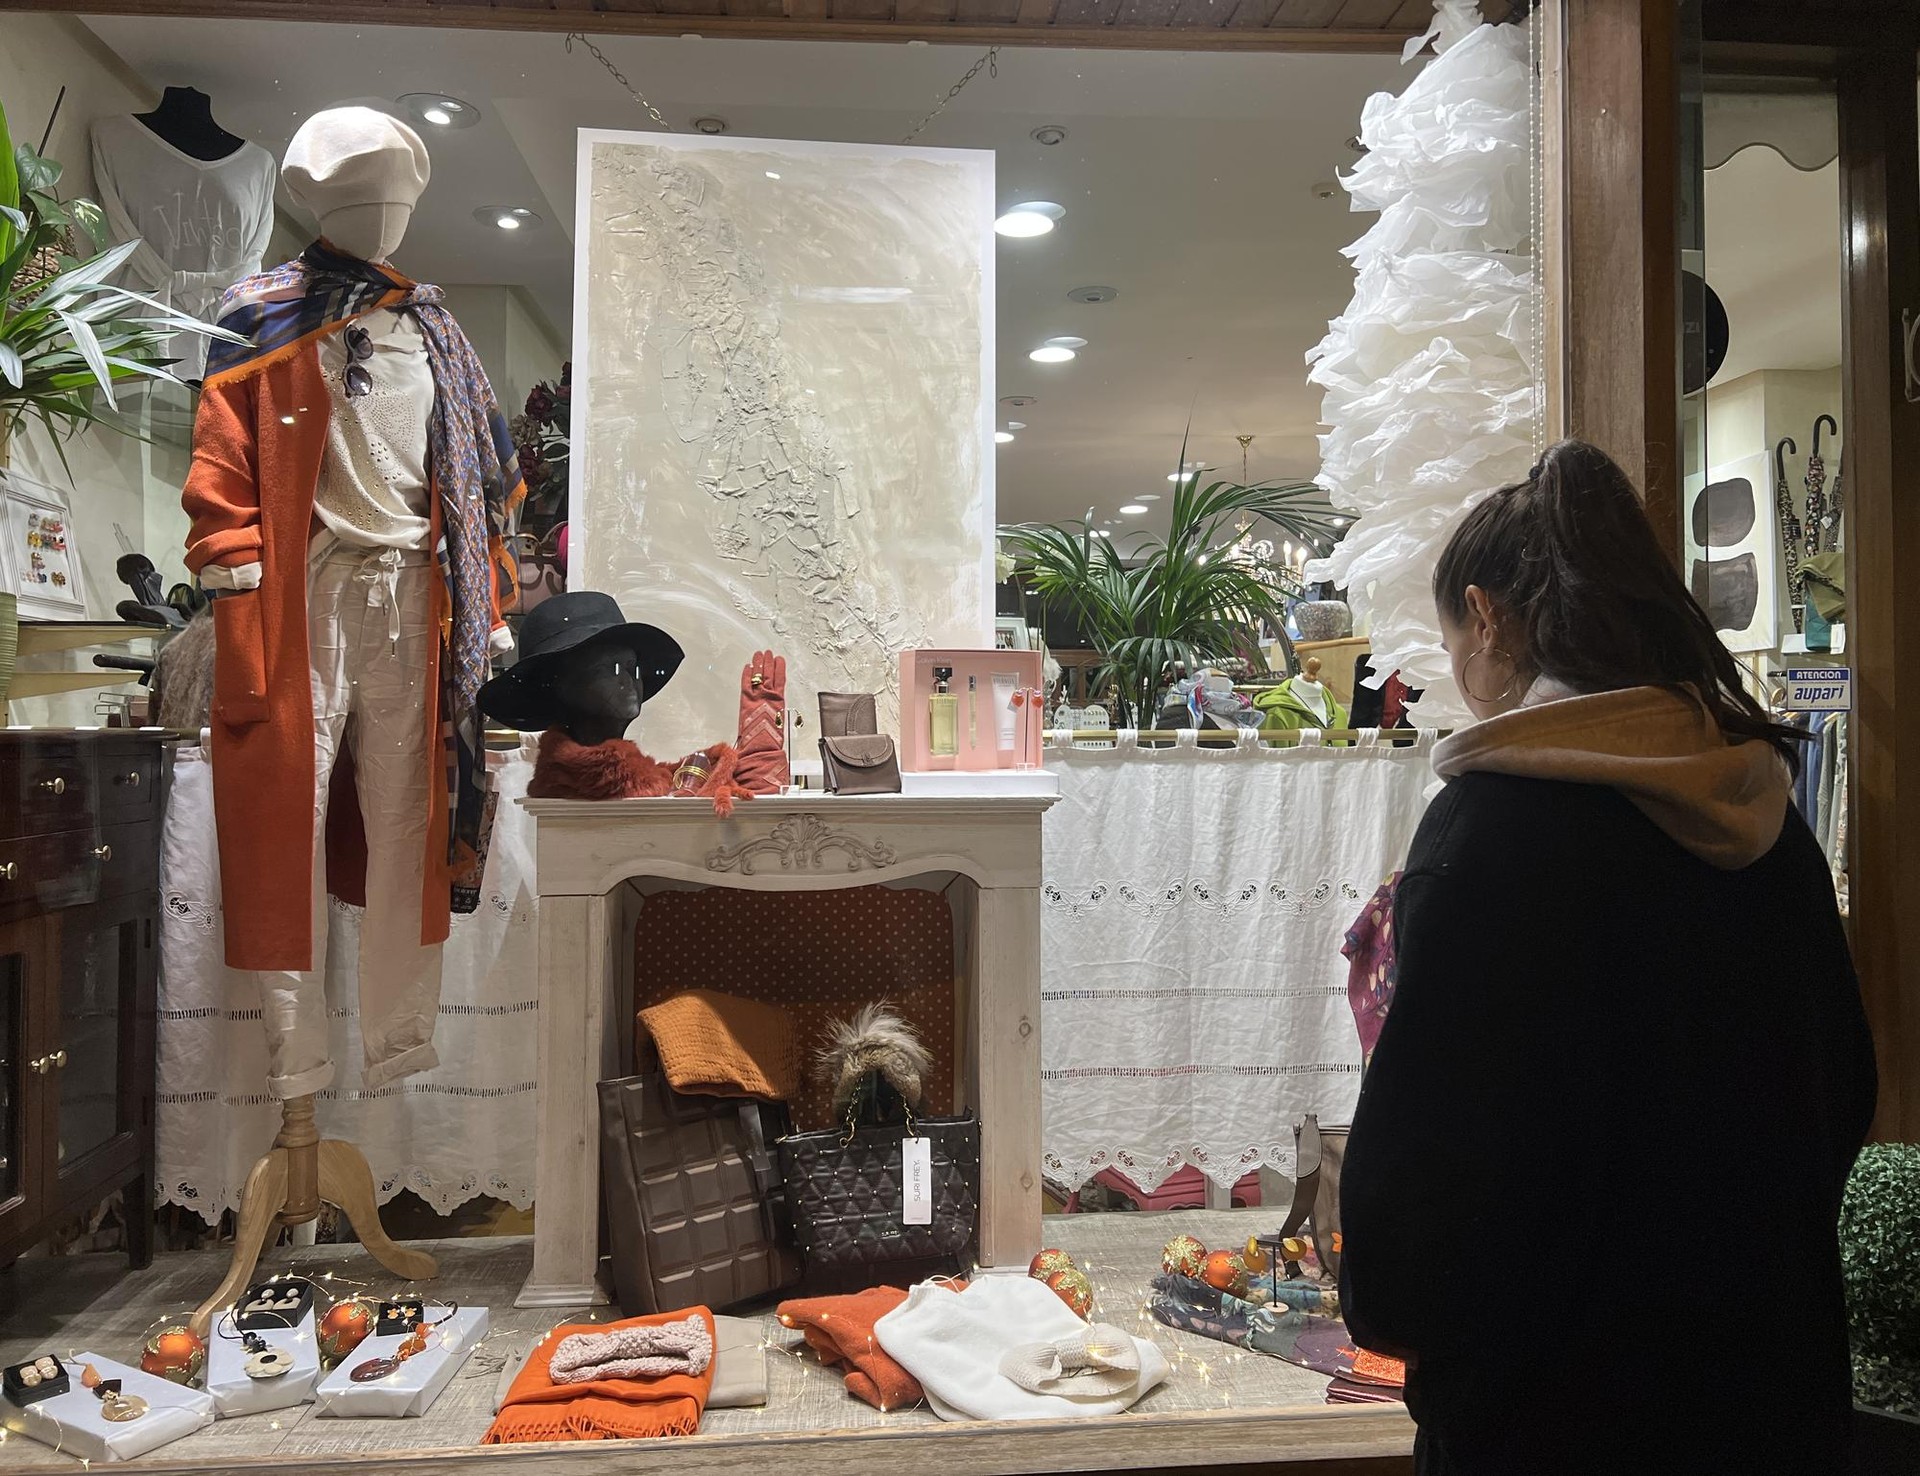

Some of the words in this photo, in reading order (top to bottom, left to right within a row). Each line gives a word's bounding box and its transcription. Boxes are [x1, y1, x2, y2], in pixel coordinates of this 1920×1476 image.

[1796, 671, 1841, 680] ATENCION
[1794, 685, 1845, 704] aupari
[913, 1183, 921, 1202] SURI
